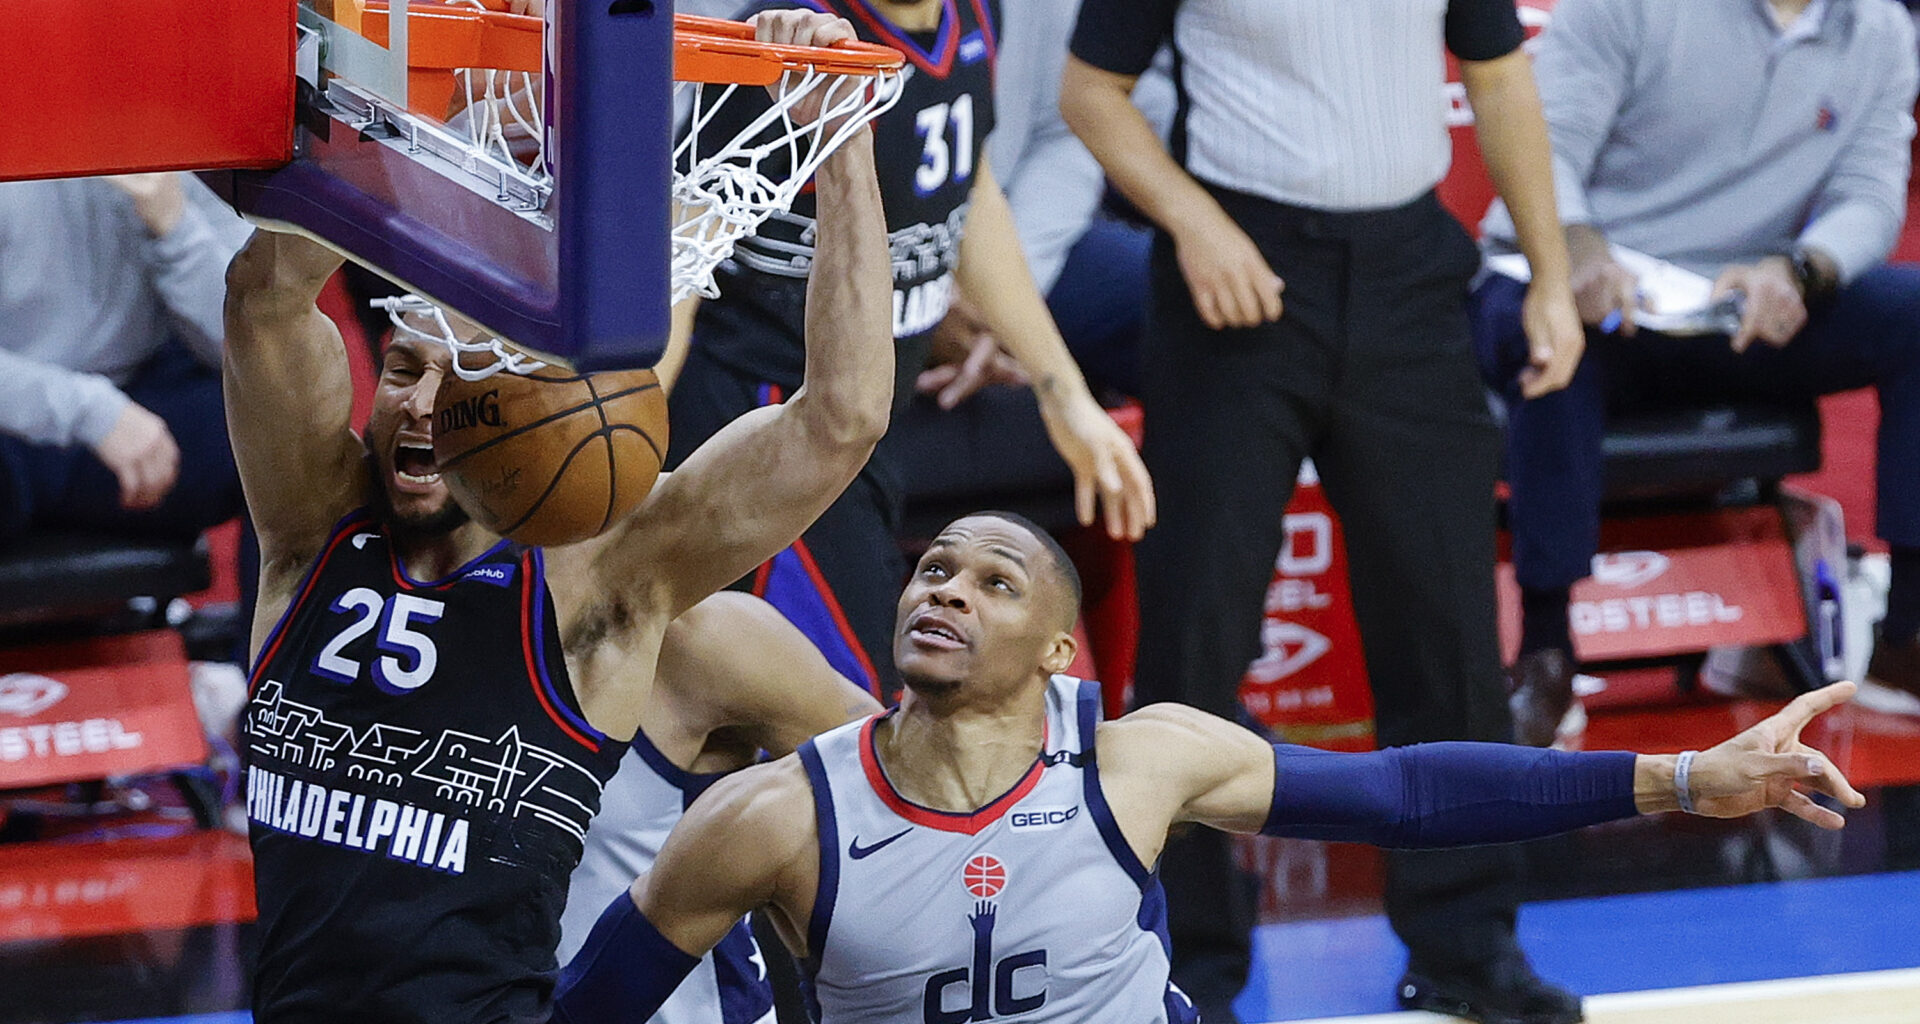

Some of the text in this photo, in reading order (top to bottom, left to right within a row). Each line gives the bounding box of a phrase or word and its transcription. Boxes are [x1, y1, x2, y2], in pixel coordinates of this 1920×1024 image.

[914, 93, 973, 194] 31
[311, 587, 445, 695] 25
[247, 765, 469, 875] PHILADELPHIA
[1011, 805, 1079, 827] GEICO
